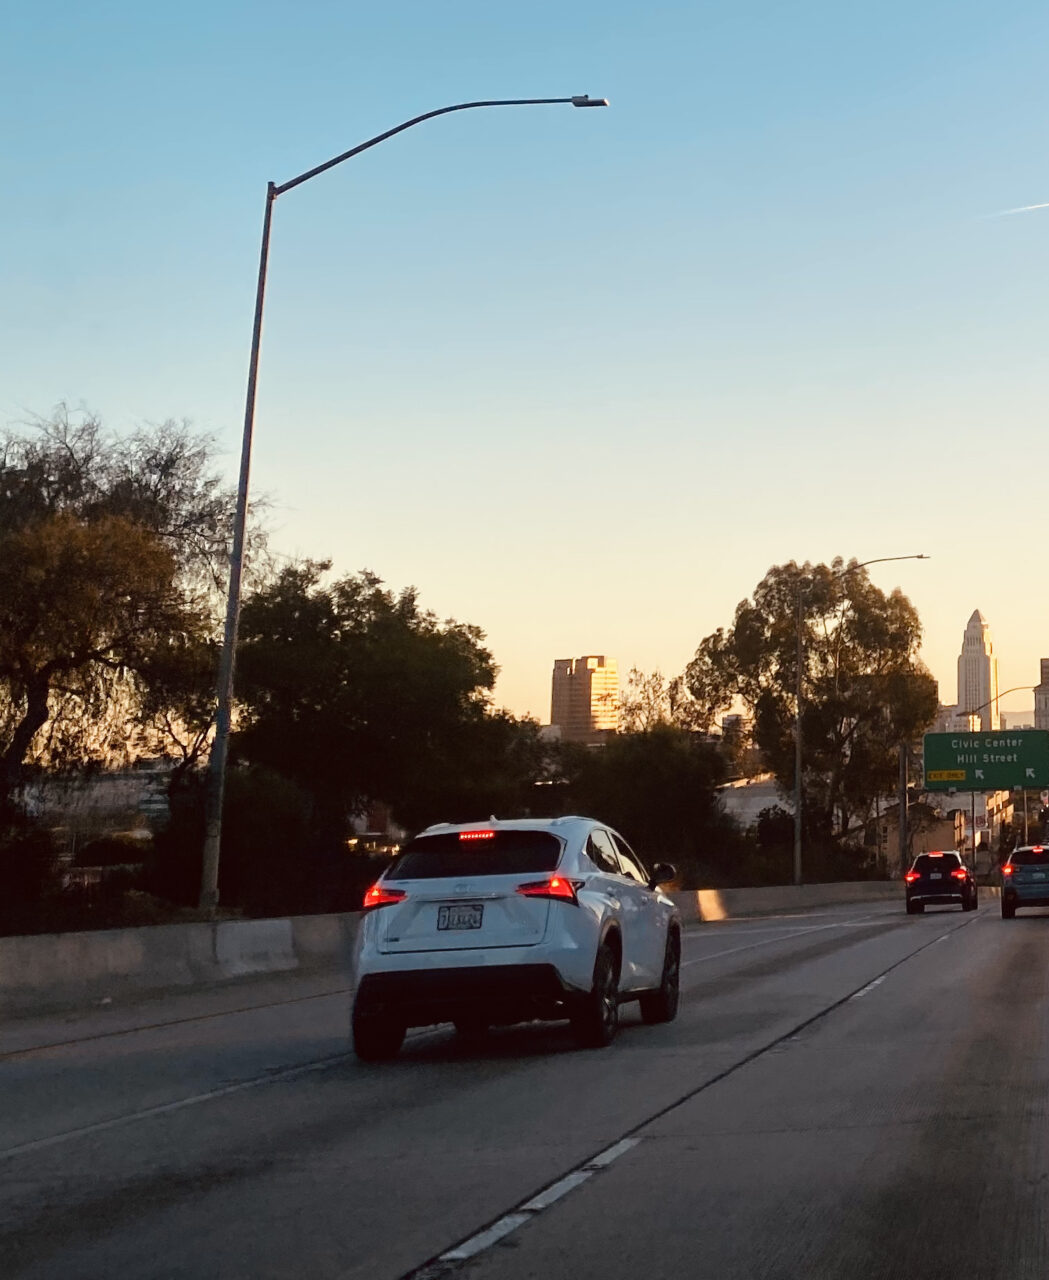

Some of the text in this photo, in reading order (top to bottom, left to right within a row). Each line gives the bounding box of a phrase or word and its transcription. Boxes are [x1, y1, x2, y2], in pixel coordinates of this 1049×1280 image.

[951, 738, 1023, 748] Civic Center
[957, 753, 1017, 763] Hill Street
